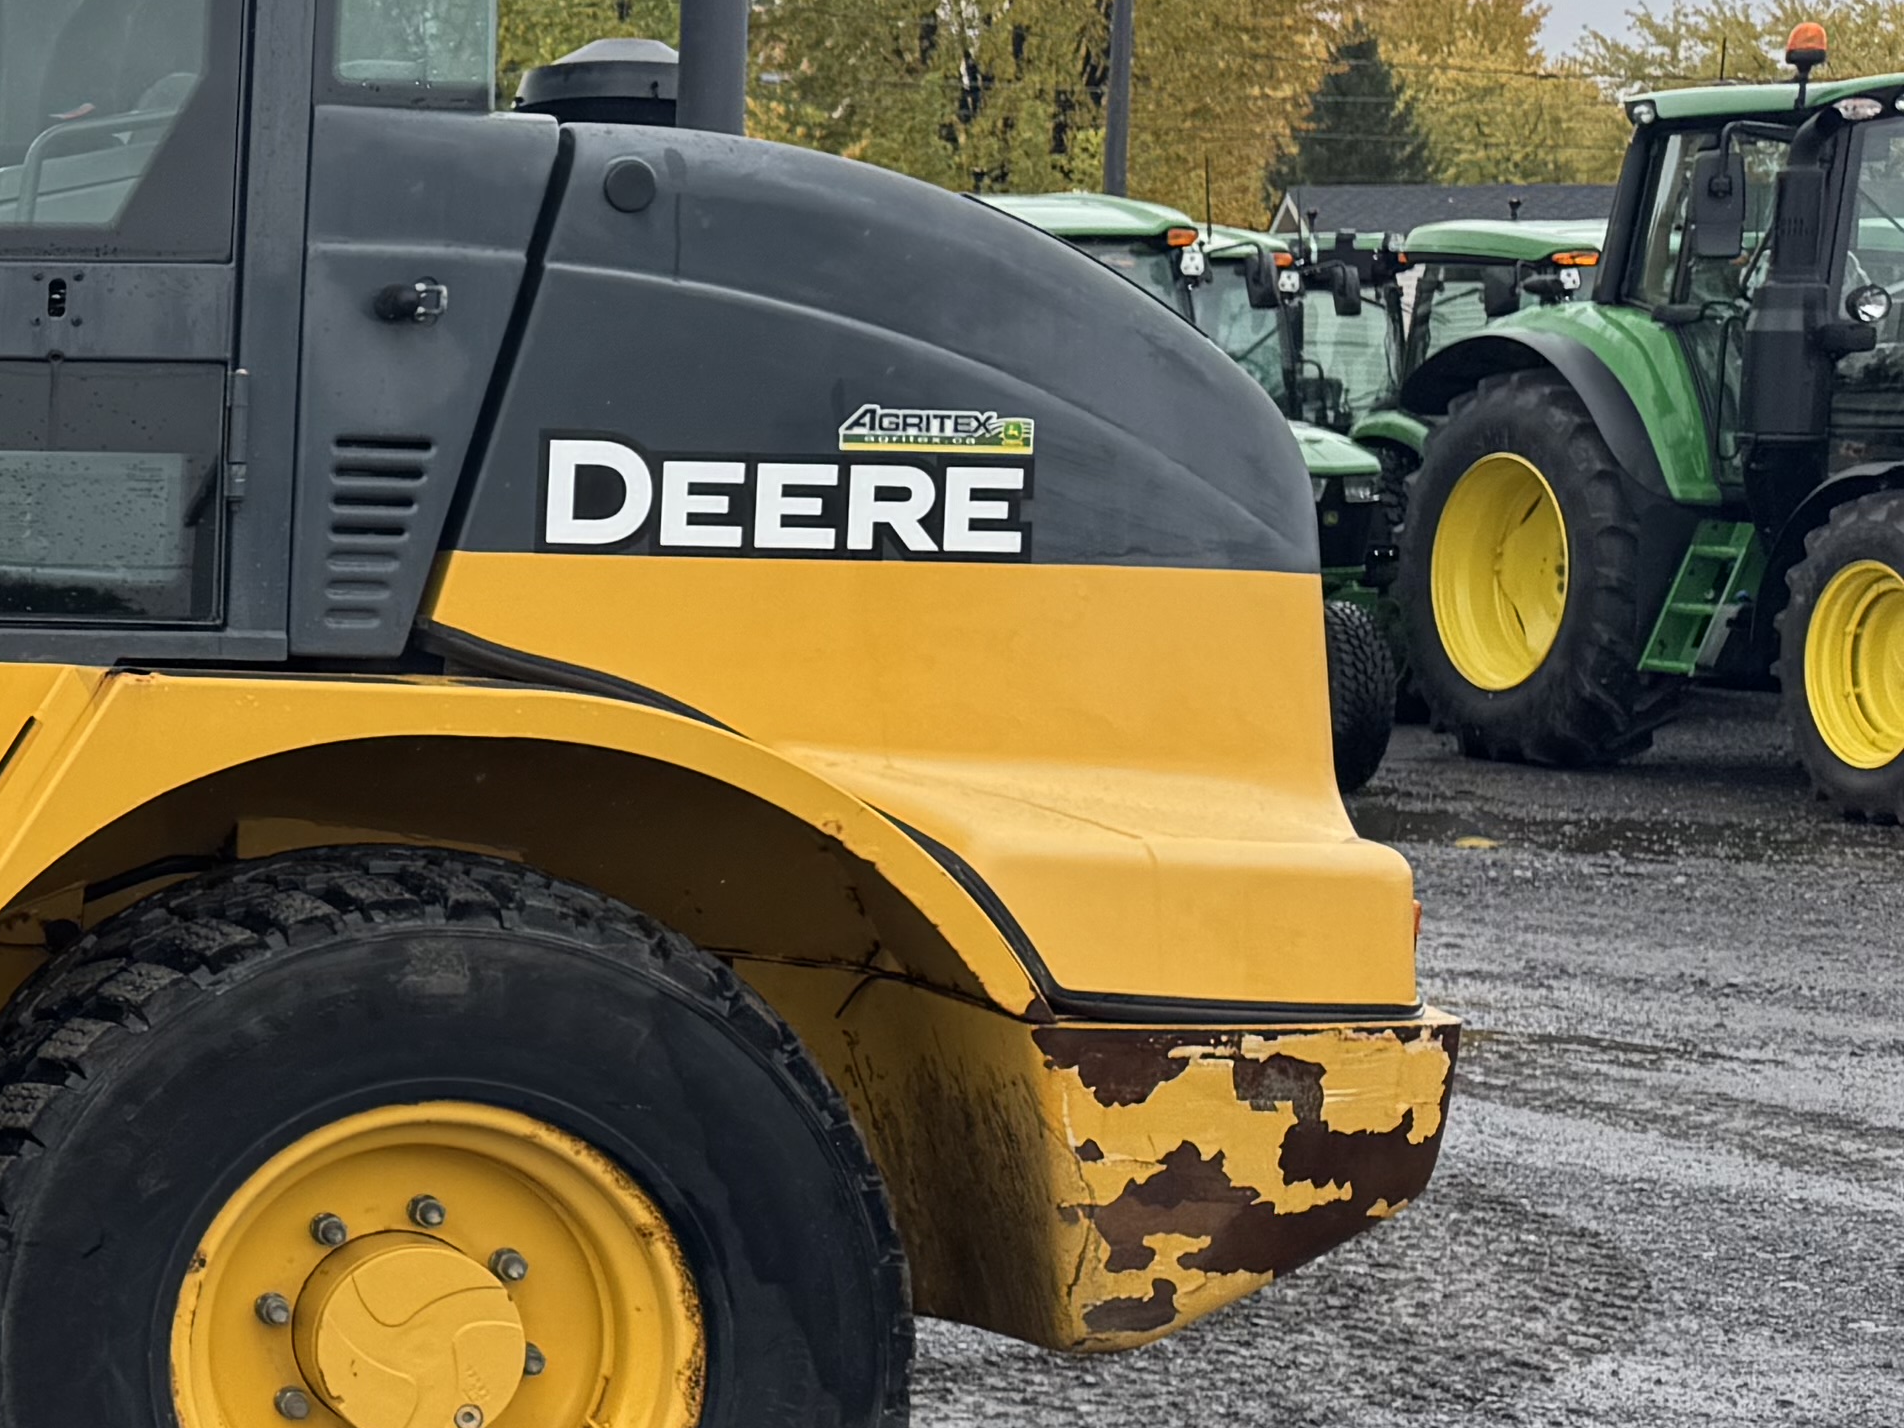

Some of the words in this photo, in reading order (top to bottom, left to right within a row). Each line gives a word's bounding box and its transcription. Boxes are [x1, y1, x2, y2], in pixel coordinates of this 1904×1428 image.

[844, 408, 995, 434] AGRITEX
[864, 434, 976, 446] agritex.ca
[545, 438, 1025, 554] DEERE
